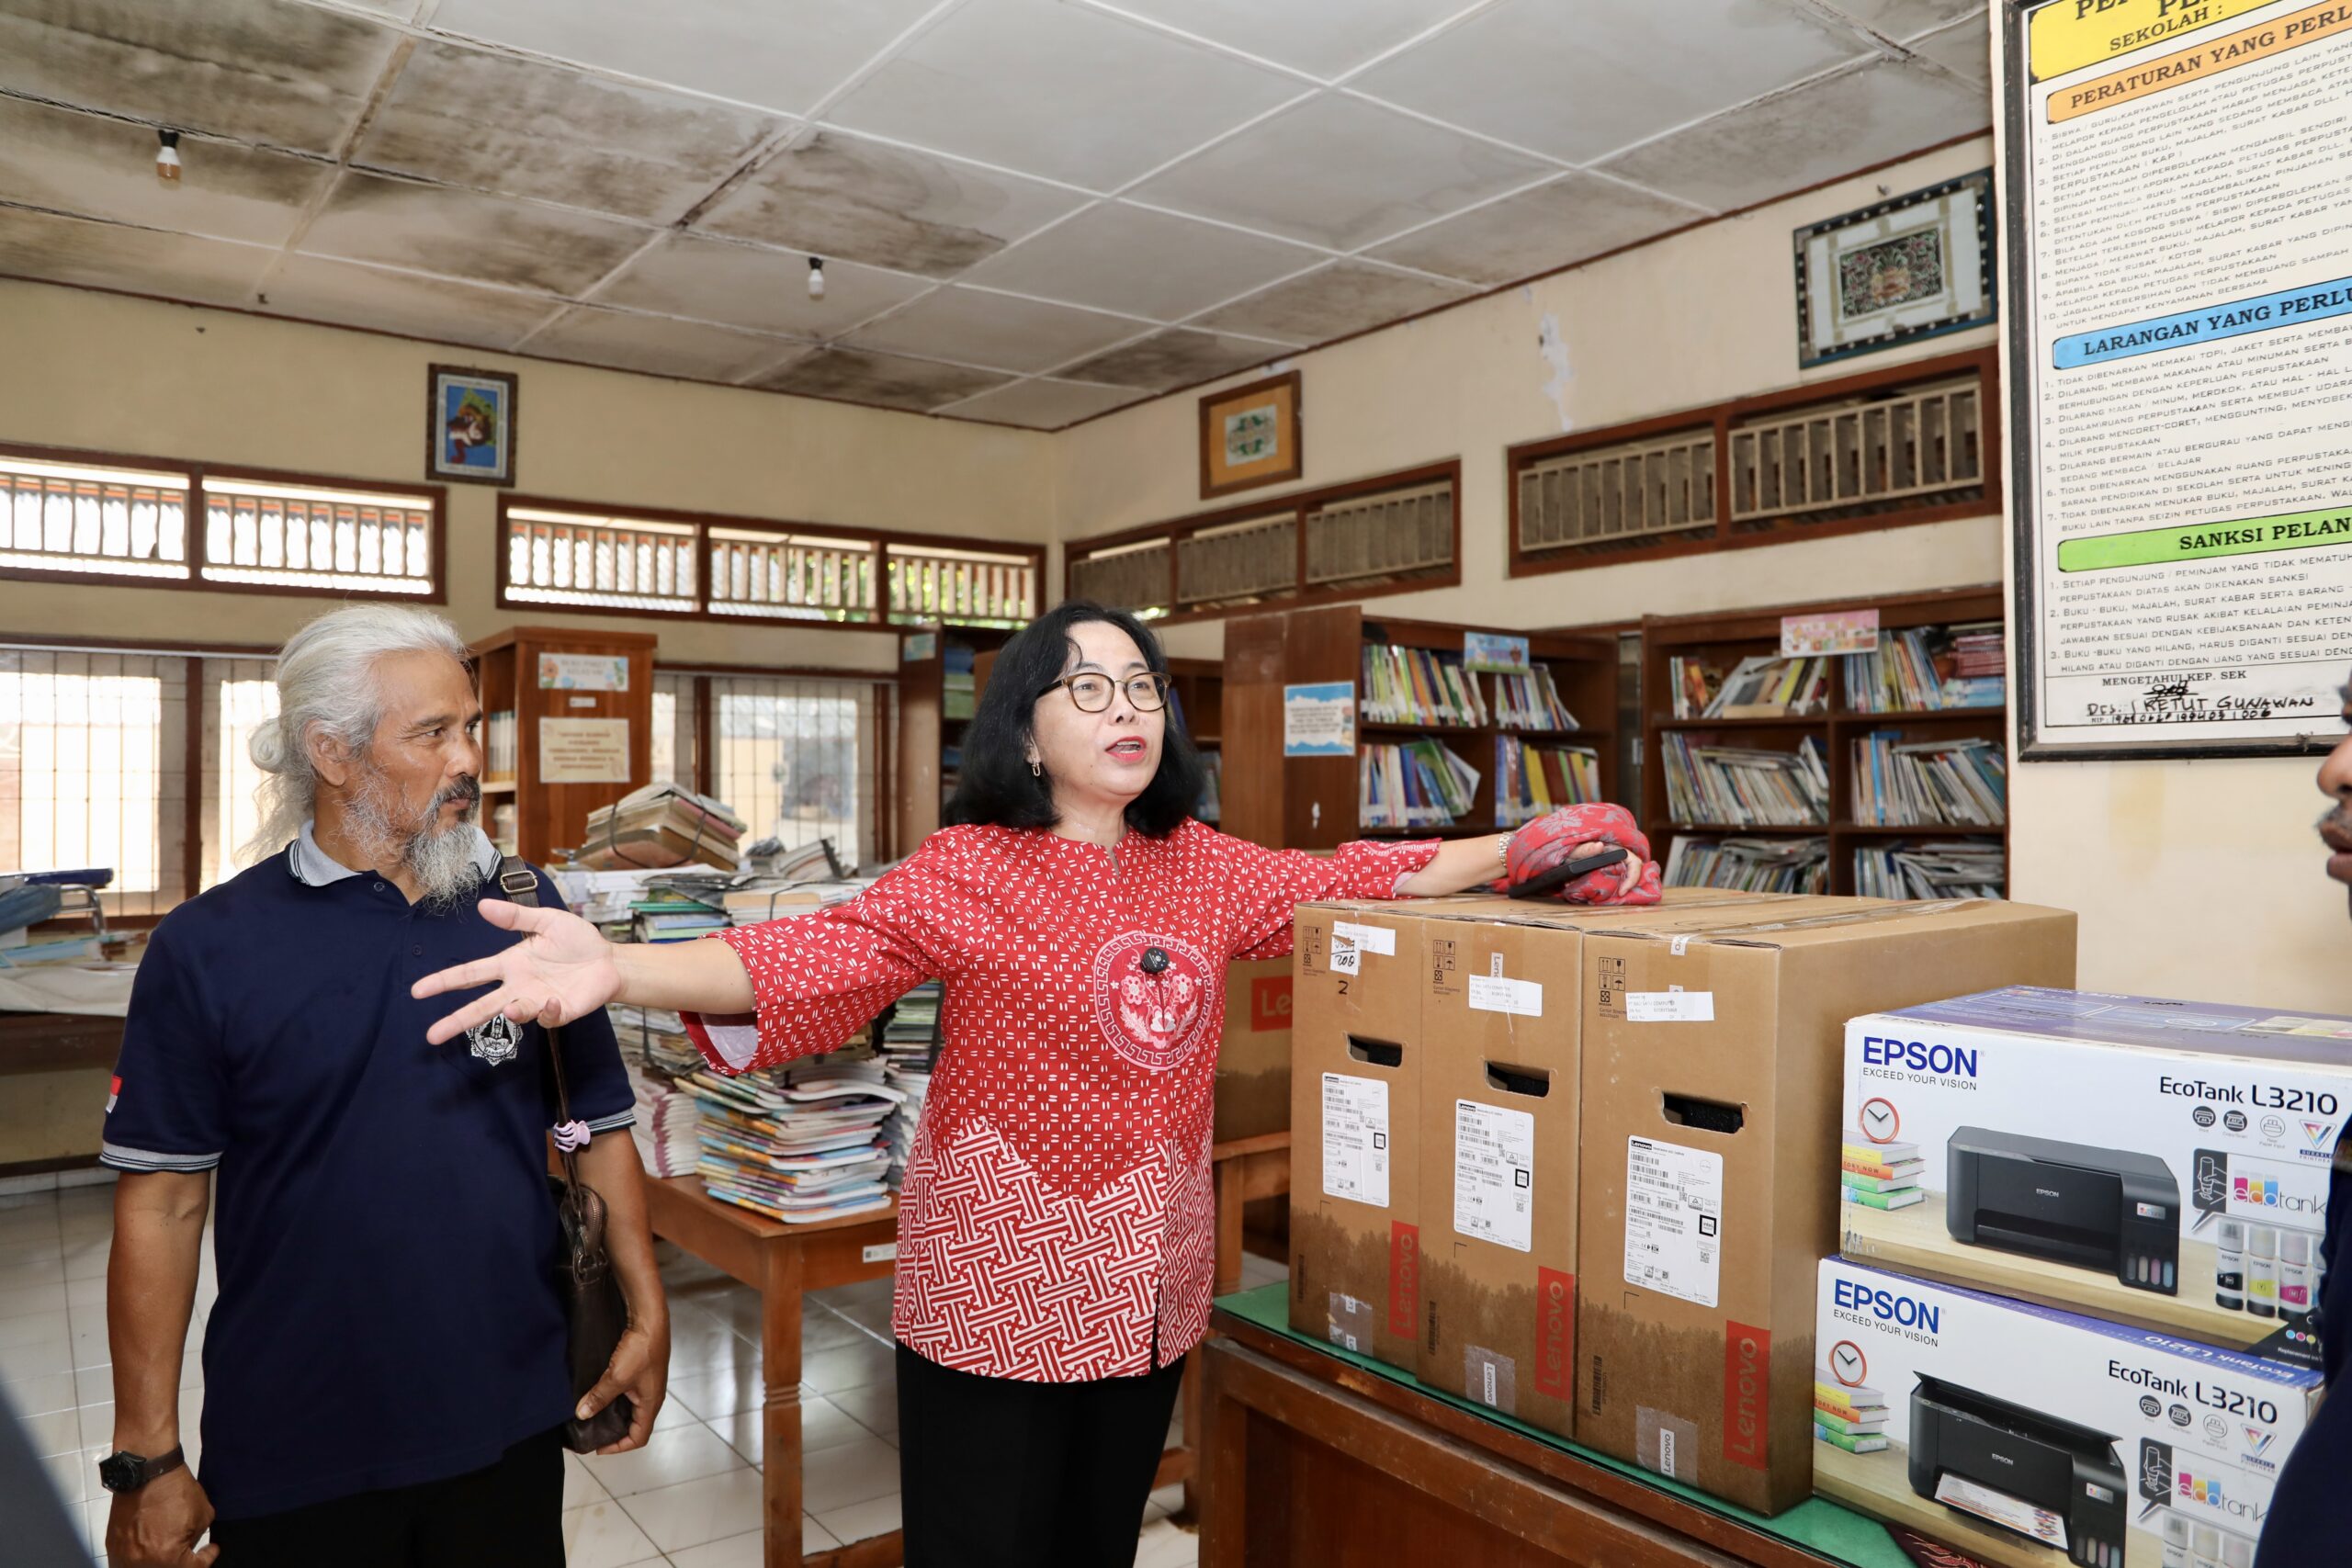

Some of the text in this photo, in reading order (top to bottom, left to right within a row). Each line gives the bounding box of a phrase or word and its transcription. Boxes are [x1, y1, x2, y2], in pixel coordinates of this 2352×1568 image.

[2109, 6, 2209, 51] SEKOLAH
[2071, 54, 2202, 108] PERATURAN
[2210, 31, 2277, 63] YANG
[2085, 319, 2200, 356] LARANGAN
[2207, 306, 2271, 332] YANG
[2179, 517, 2352, 550] SANKSI PELAN
[2059, 617, 2311, 646] JAWABKAN SESUAI DENGAN KEBIJAKSANAAN DAN
[2060, 648, 2321, 673] HILANG ATAU DIGANTI DENGAN UANG YANG SESUAI
[2219, 669, 2247, 681] SEK
[2143, 697, 2209, 714] KETUT
[2216, 695, 2314, 711] GUNAWAN
[1338, 980, 1349, 996] 2
[1863, 1036, 1977, 1077] EPSON
[1862, 1066, 1977, 1091] EXCEED YOUR VISION
[2160, 1076, 2338, 1116] EcoTank L3210
[2036, 1188, 2060, 1198] EPSON
[1396, 1234, 1413, 1329] Lenovo
[1834, 1278, 1939, 1335] EPSON
[1544, 1280, 1564, 1388] Lenovo
[1834, 1309, 1939, 1348] EXCEED YOUR VISION
[2144, 1335, 2213, 1358] L3210
[1734, 1337, 1758, 1456] Lenovo
[2109, 1359, 2278, 1425] EcoTank L3210
[1664, 1433, 1672, 1472] Lenovo
[1992, 1452, 2014, 1466] EPSON
